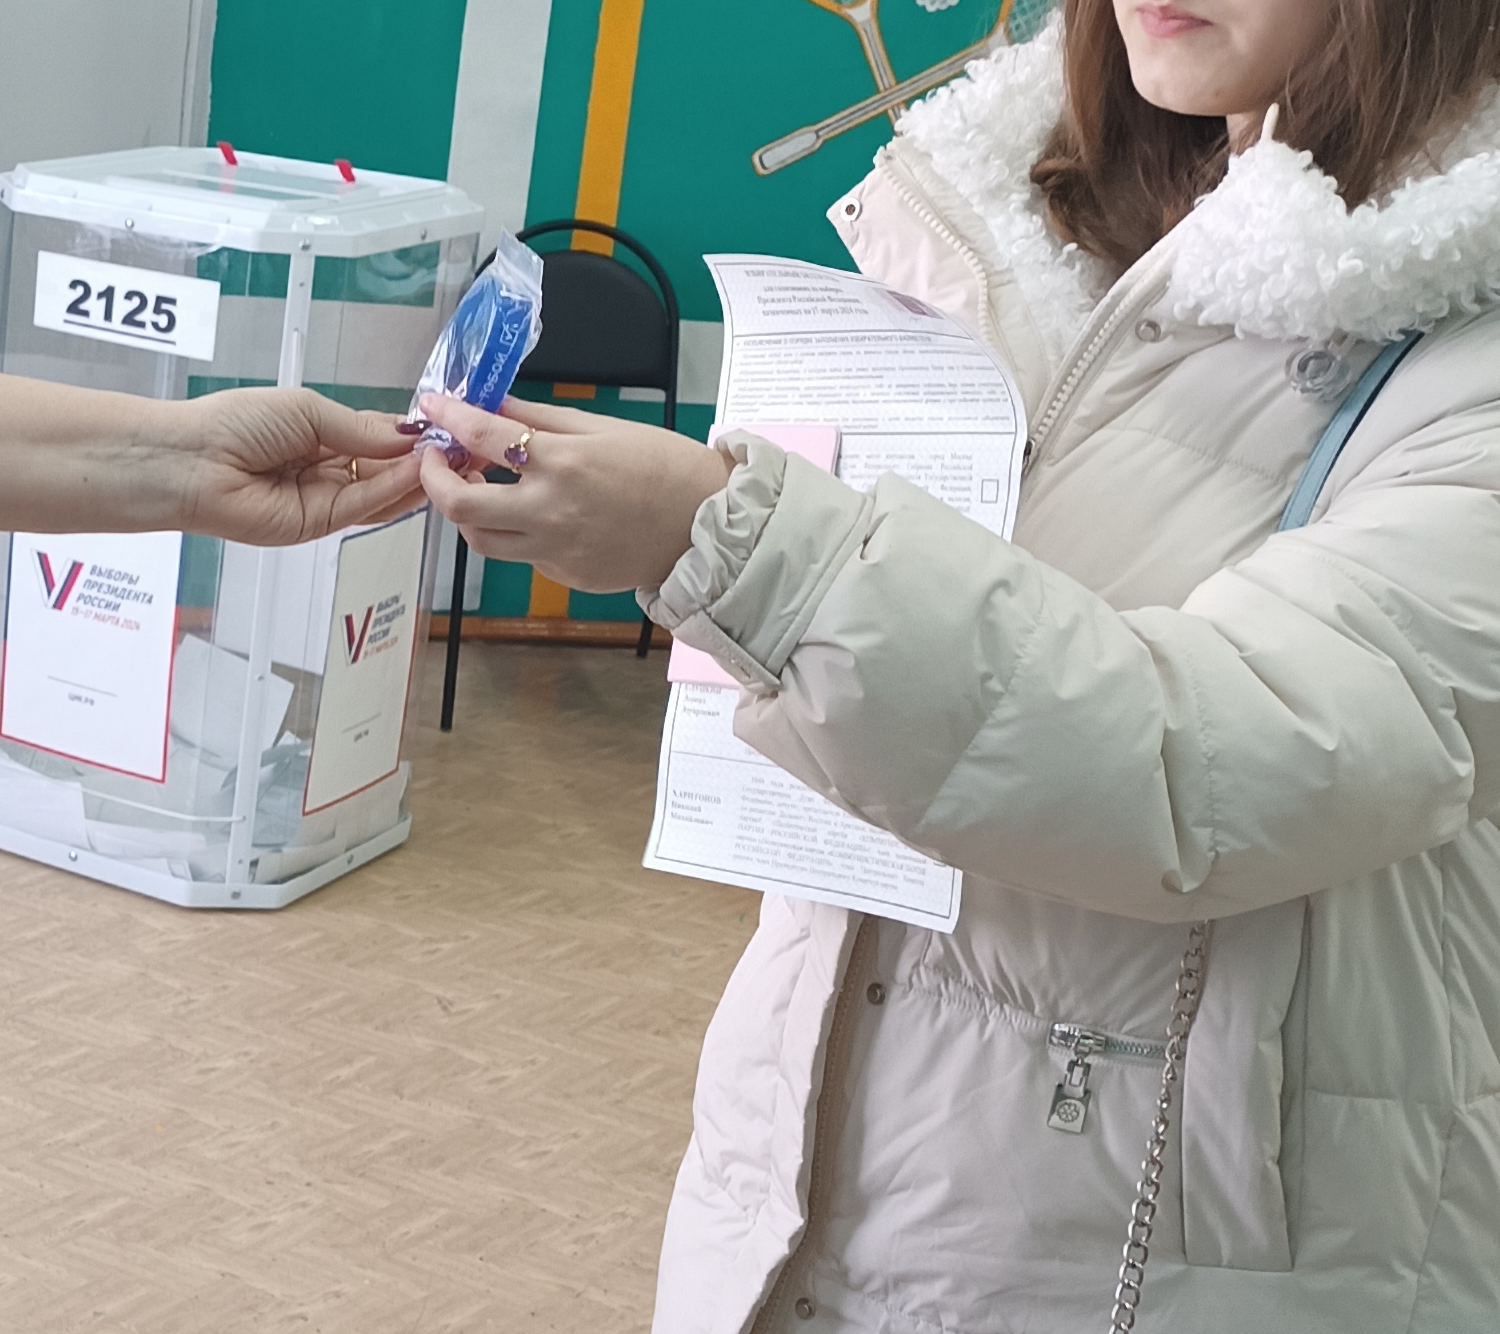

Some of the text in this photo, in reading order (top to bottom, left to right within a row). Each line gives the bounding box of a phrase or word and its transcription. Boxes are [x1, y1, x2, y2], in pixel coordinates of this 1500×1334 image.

[66, 279, 177, 334] 2125
[90, 565, 139, 585] ВЫБОРЫ
[76, 593, 121, 612] РОССИИ
[83, 579, 153, 605] ПРЕЗИДЕНТА
